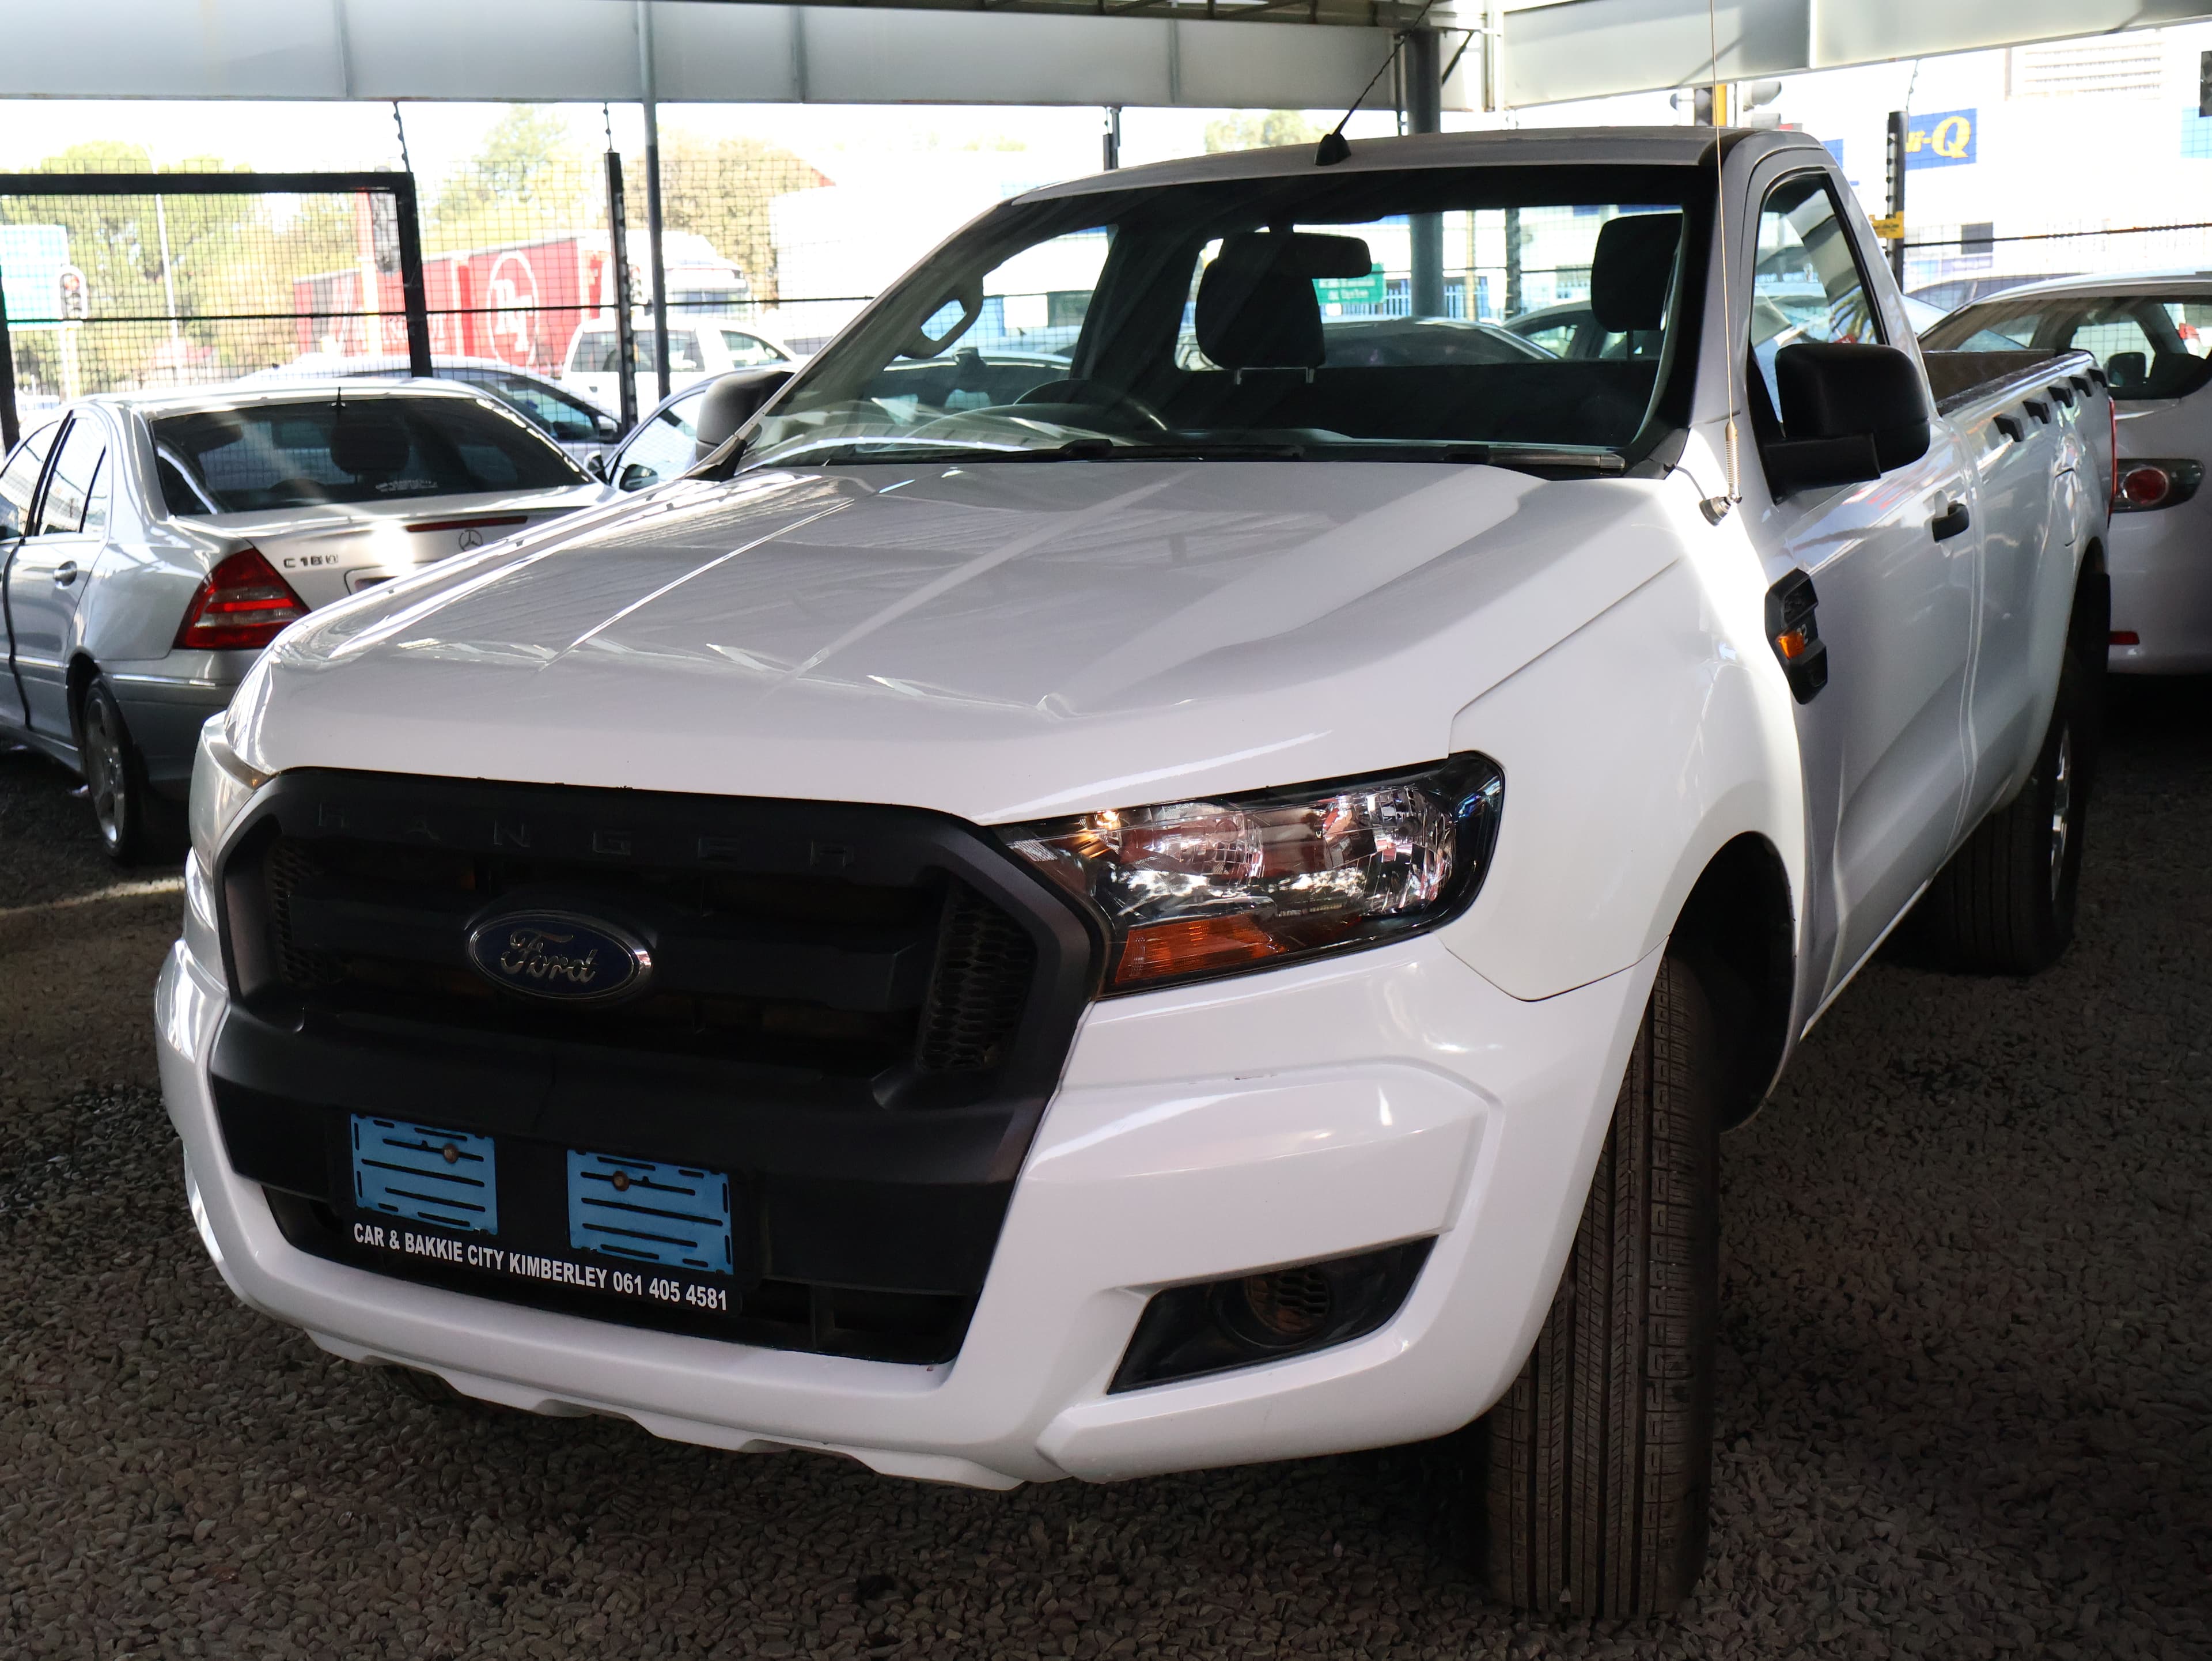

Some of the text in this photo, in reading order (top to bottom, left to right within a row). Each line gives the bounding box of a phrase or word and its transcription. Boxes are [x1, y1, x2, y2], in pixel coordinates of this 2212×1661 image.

[317, 801, 856, 868] RANGER
[500, 928, 599, 983] Ford
[354, 1223, 727, 1311] CAR & BAKKIE CITY KIMBERLEY 061 405 4581
